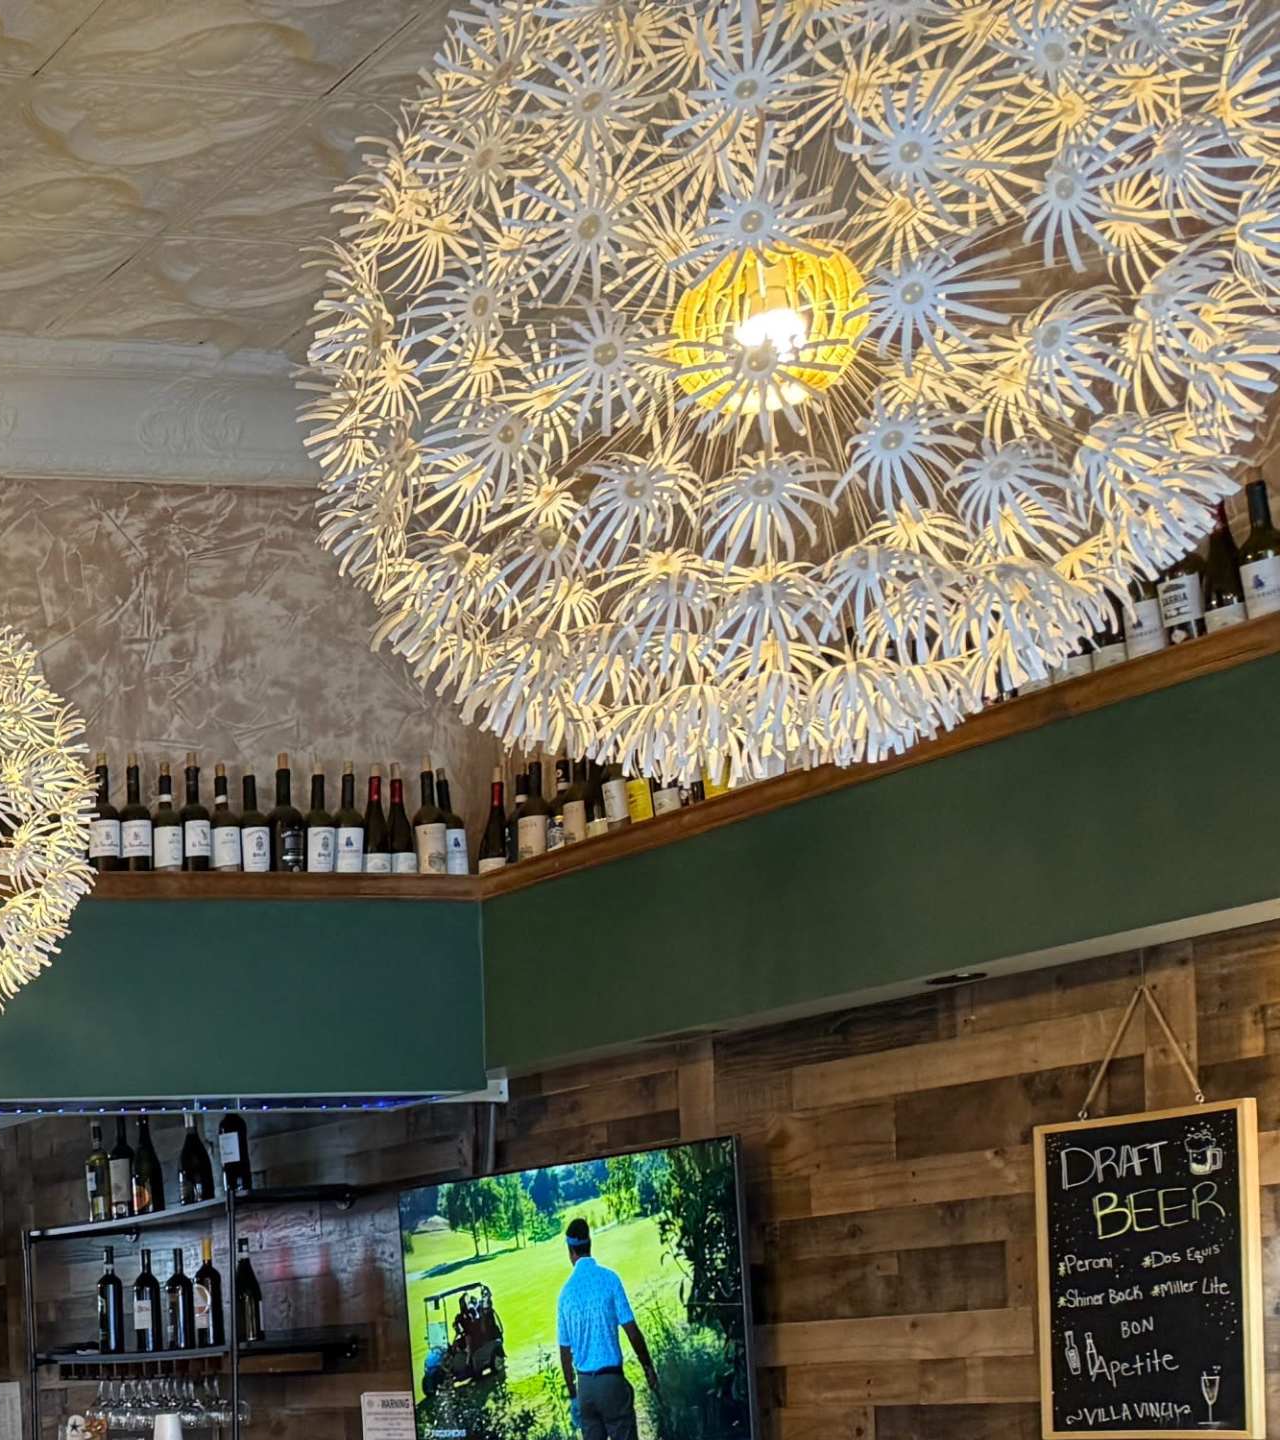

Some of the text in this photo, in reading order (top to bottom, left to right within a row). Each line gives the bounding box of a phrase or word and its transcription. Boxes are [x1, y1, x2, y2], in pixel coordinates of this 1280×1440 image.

[1060, 1141, 1168, 1191] DRAFT
[1092, 1181, 1226, 1240] BEER
[1064, 1254, 1113, 1275] Peroni
[1151, 1251, 1182, 1268] Dos
[1065, 1289, 1105, 1308] Shiner
[1160, 1280, 1198, 1298] Miller
[1202, 1276, 1230, 1296] Lite
[1120, 1316, 1154, 1338] BON
[1091, 1348, 1180, 1388] Apetite
[1084, 1401, 1173, 1425] VILLA VINCI
